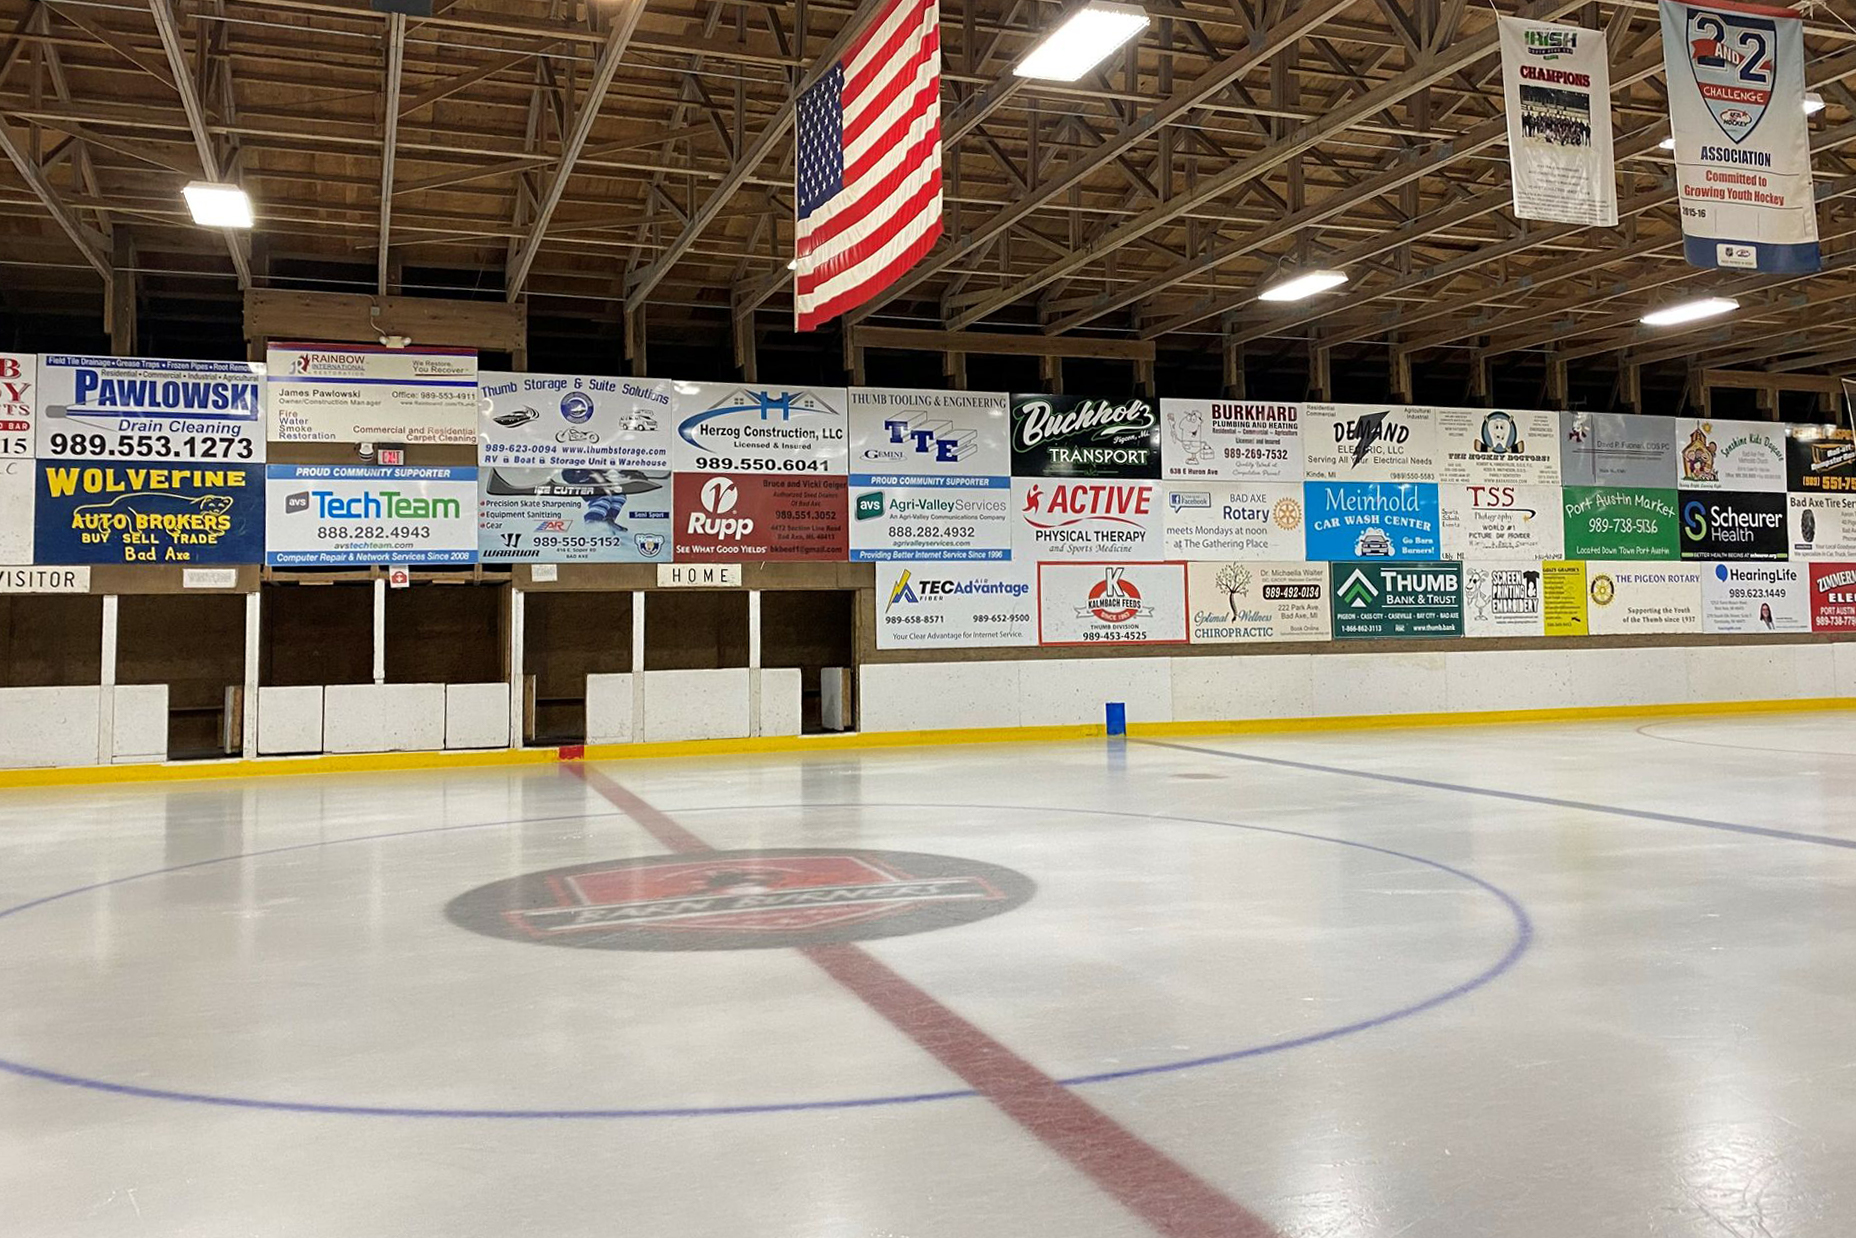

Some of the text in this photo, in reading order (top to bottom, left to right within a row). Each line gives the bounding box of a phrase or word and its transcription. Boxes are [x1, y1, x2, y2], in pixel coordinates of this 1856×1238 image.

[1715, 42, 1740, 66] AND
[1736, 30, 1770, 85] 2
[1520, 65, 1590, 87] CHAMPIONS
[1703, 86, 1764, 103] CHALLENGE
[1701, 146, 1771, 167] ASSOCIATION
[1705, 170, 1767, 187] Committed to
[1684, 185, 1784, 206] Growing Youth Hockey
[81, 358, 139, 368] Drainage Grease
[312, 354, 365, 365] RAINBOW
[75, 369, 259, 411] PAWLOWSKI
[279, 389, 361, 399] James Pawlowski
[481, 378, 669, 404] Thumb Storage & Suite Solutions
[852, 393, 1007, 409] THUMB TOOLING & ENGINEERING
[279, 410, 297, 418] Fire
[1211, 404, 1298, 422] BURKHARD
[118, 419, 241, 436] Drain Cleaning
[1020, 399, 1155, 446] Buchholz
[1212, 420, 1298, 430] PLUMBING AND HEATING
[279, 425, 312, 433] Smoke
[353, 425, 424, 435] Commercial and
[700, 424, 843, 439] Herzog LLC
[1333, 420, 1409, 444] DEMAND
[279, 432, 336, 440] Restoration
[406, 434, 437, 443] Carpet
[50, 433, 253, 458] 989.553.1273
[485, 444, 557, 454] 989-623-0094
[734, 442, 770, 450] Licensed
[1388, 446, 1404, 455] LLC
[382, 450, 401, 464] EXIT
[1048, 448, 1148, 463] TRANSPORT
[1224, 448, 1288, 460] 989-269-7532
[514, 456, 535, 464] Boat
[618, 459, 666, 467] Warehouse
[695, 457, 829, 471] 989.550.6041
[1308, 456, 1348, 466] Serving All
[296, 468, 450, 479] PROUD COMMUNITY SUPPORTER
[871, 476, 989, 486] PROUD COMMUNITY SUPPORTER
[1046, 485, 1153, 514] ACTIVE
[1230, 494, 1267, 503] BAD AXE
[1325, 484, 1421, 511] Meinhold
[1466, 486, 1515, 507] TSS
[1791, 497, 1841, 508] Bad Axe Tire
[312, 491, 460, 519] TechTeam
[486, 500, 519, 508] Precision
[542, 501, 581, 510] Sharpening
[860, 500, 881, 510] avs
[1565, 492, 1676, 518] Port Austin Market
[486, 511, 525, 520] Equipment
[1223, 506, 1270, 523] Rotary
[1711, 506, 1783, 528] Scheurer
[72, 513, 232, 530] AUTO BROKERS
[686, 512, 754, 541] Rupp
[1314, 514, 1432, 531] CAR WASH CENTER
[1589, 518, 1658, 533] 989-738-5136
[318, 526, 430, 539] 888.282.4943
[889, 526, 975, 538] 888.282.4932
[1036, 530, 1146, 542] PHYSICAL THERAPY
[1166, 527, 1193, 535] meets
[1195, 526, 1233, 537] Mondays
[1235, 527, 1243, 535] at
[1711, 528, 1754, 542] Health
[82, 533, 218, 545] BUY SELL TRADE
[533, 537, 620, 547] 989-550-5152
[1184, 539, 1268, 550] The Gathering Place
[334, 541, 413, 550] avstechteam.com
[676, 545, 766, 555] SEE WHAT GOOD YIELDS
[125, 546, 190, 561] Bad Axe
[277, 552, 449, 563] Computer Repair Network Since
[482, 550, 541, 558] WARRIOR
[673, 568, 728, 582] HOME
[1616, 574, 1700, 583] THE PIGEON ROTARY
[1730, 568, 1797, 583] HearingLife
[1105, 567, 1125, 598] K
[1380, 571, 1458, 592] THUMB
[1265, 586, 1320, 599] 989-492-0134
[1729, 588, 1786, 598] 989.623.1449
[1088, 599, 1141, 609] KALMBACH FEEDS
[1386, 595, 1456, 604] BANK & TRUST
[885, 613, 1030, 624] 989-658-8571 989-652-9500
[1194, 610, 1272, 626] Optimal Wellness
[893, 631, 998, 641] Your Clear Advantage for Internet
[1082, 631, 1147, 641] 989-453-4525
[1194, 628, 1273, 639] CHIROPRACTIC
